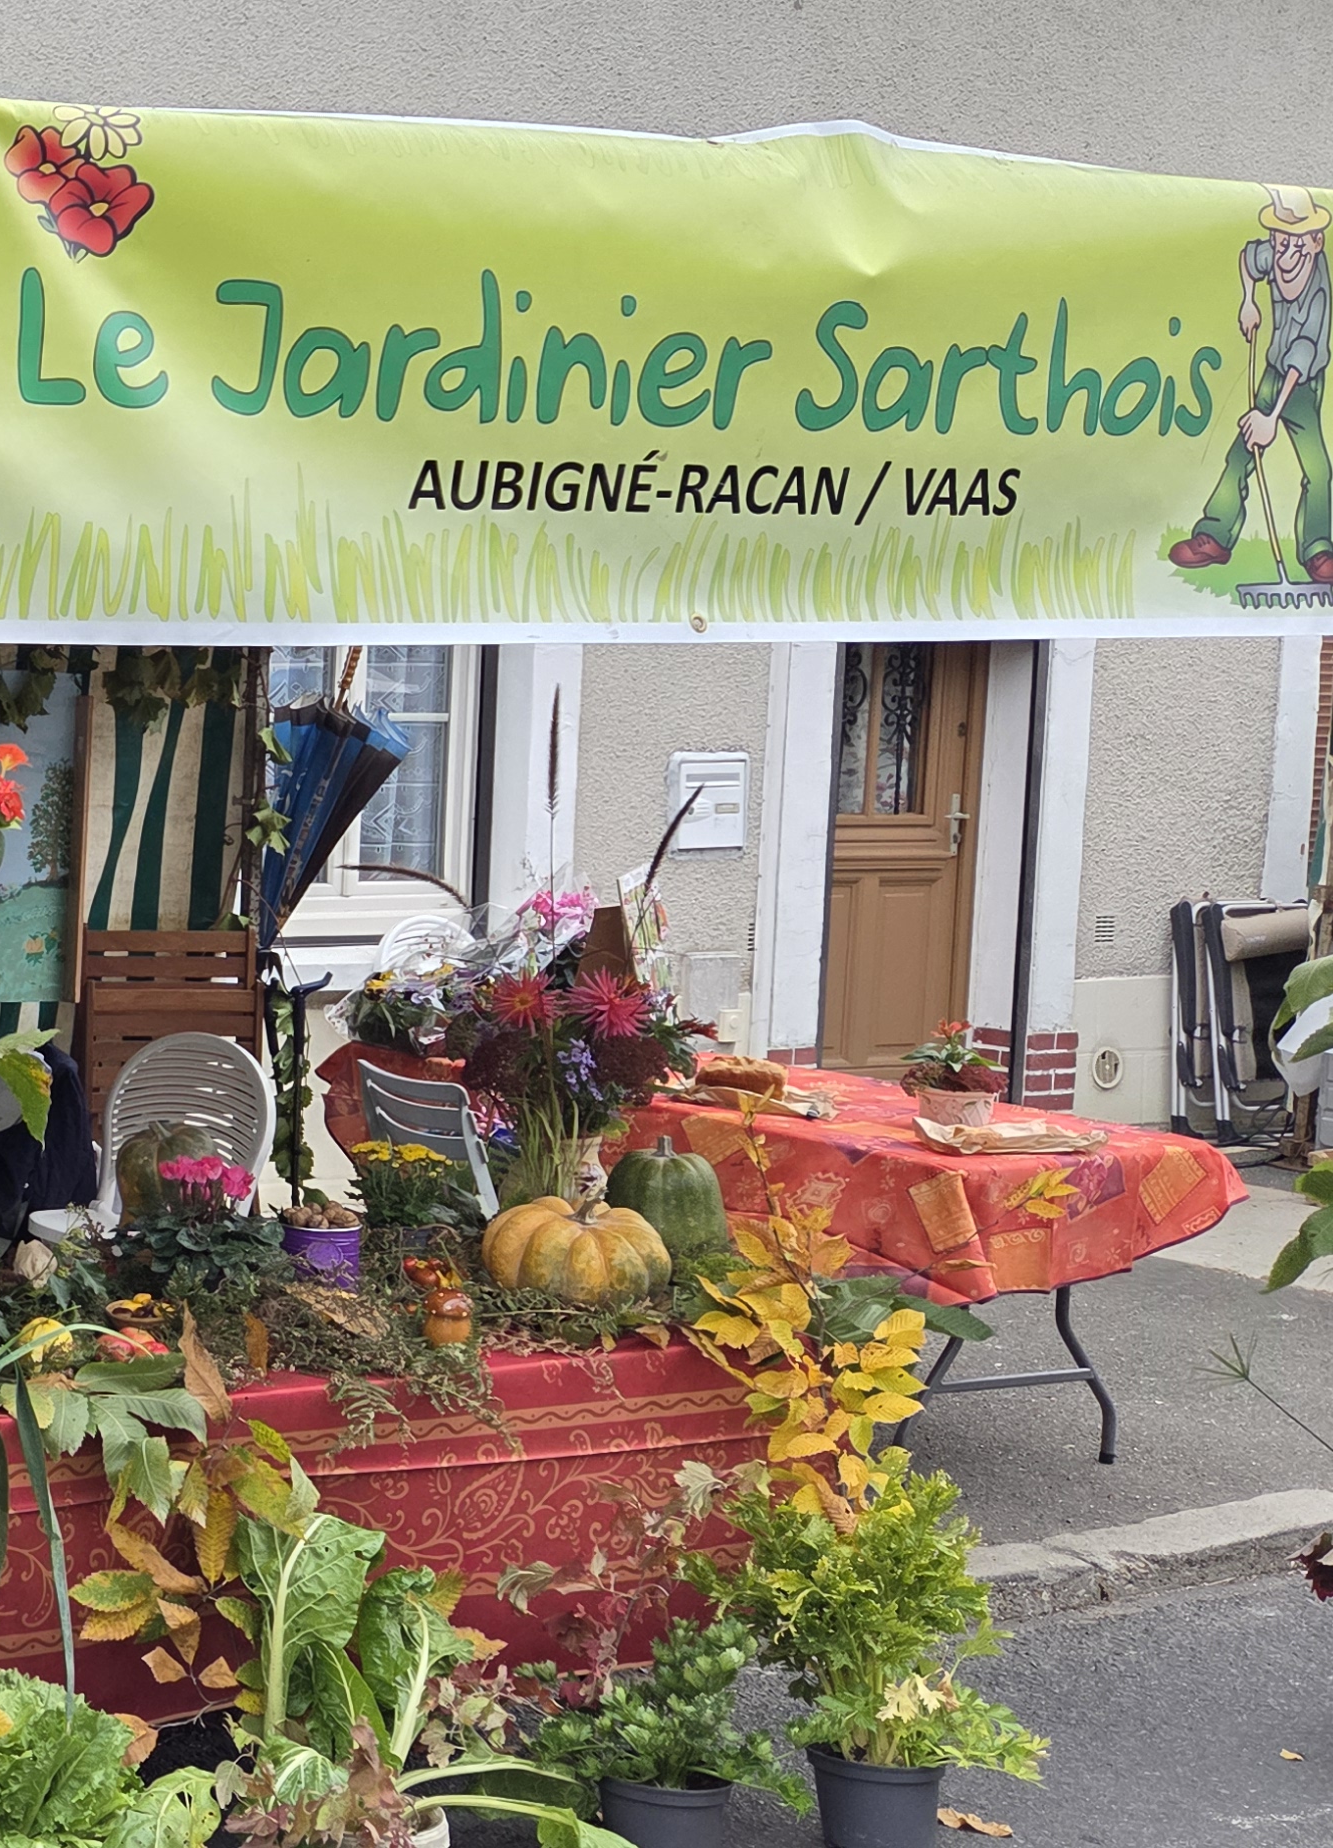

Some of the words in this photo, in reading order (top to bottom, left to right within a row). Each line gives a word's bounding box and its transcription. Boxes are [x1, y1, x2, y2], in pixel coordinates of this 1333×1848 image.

[17, 266, 169, 409] Le
[211, 269, 772, 430] Jardinier
[795, 297, 1222, 436] Sarthois
[407, 449, 850, 515] AUBIGNÉ-RACAN
[854, 461, 892, 525] /
[904, 467, 1021, 517] VAAS
